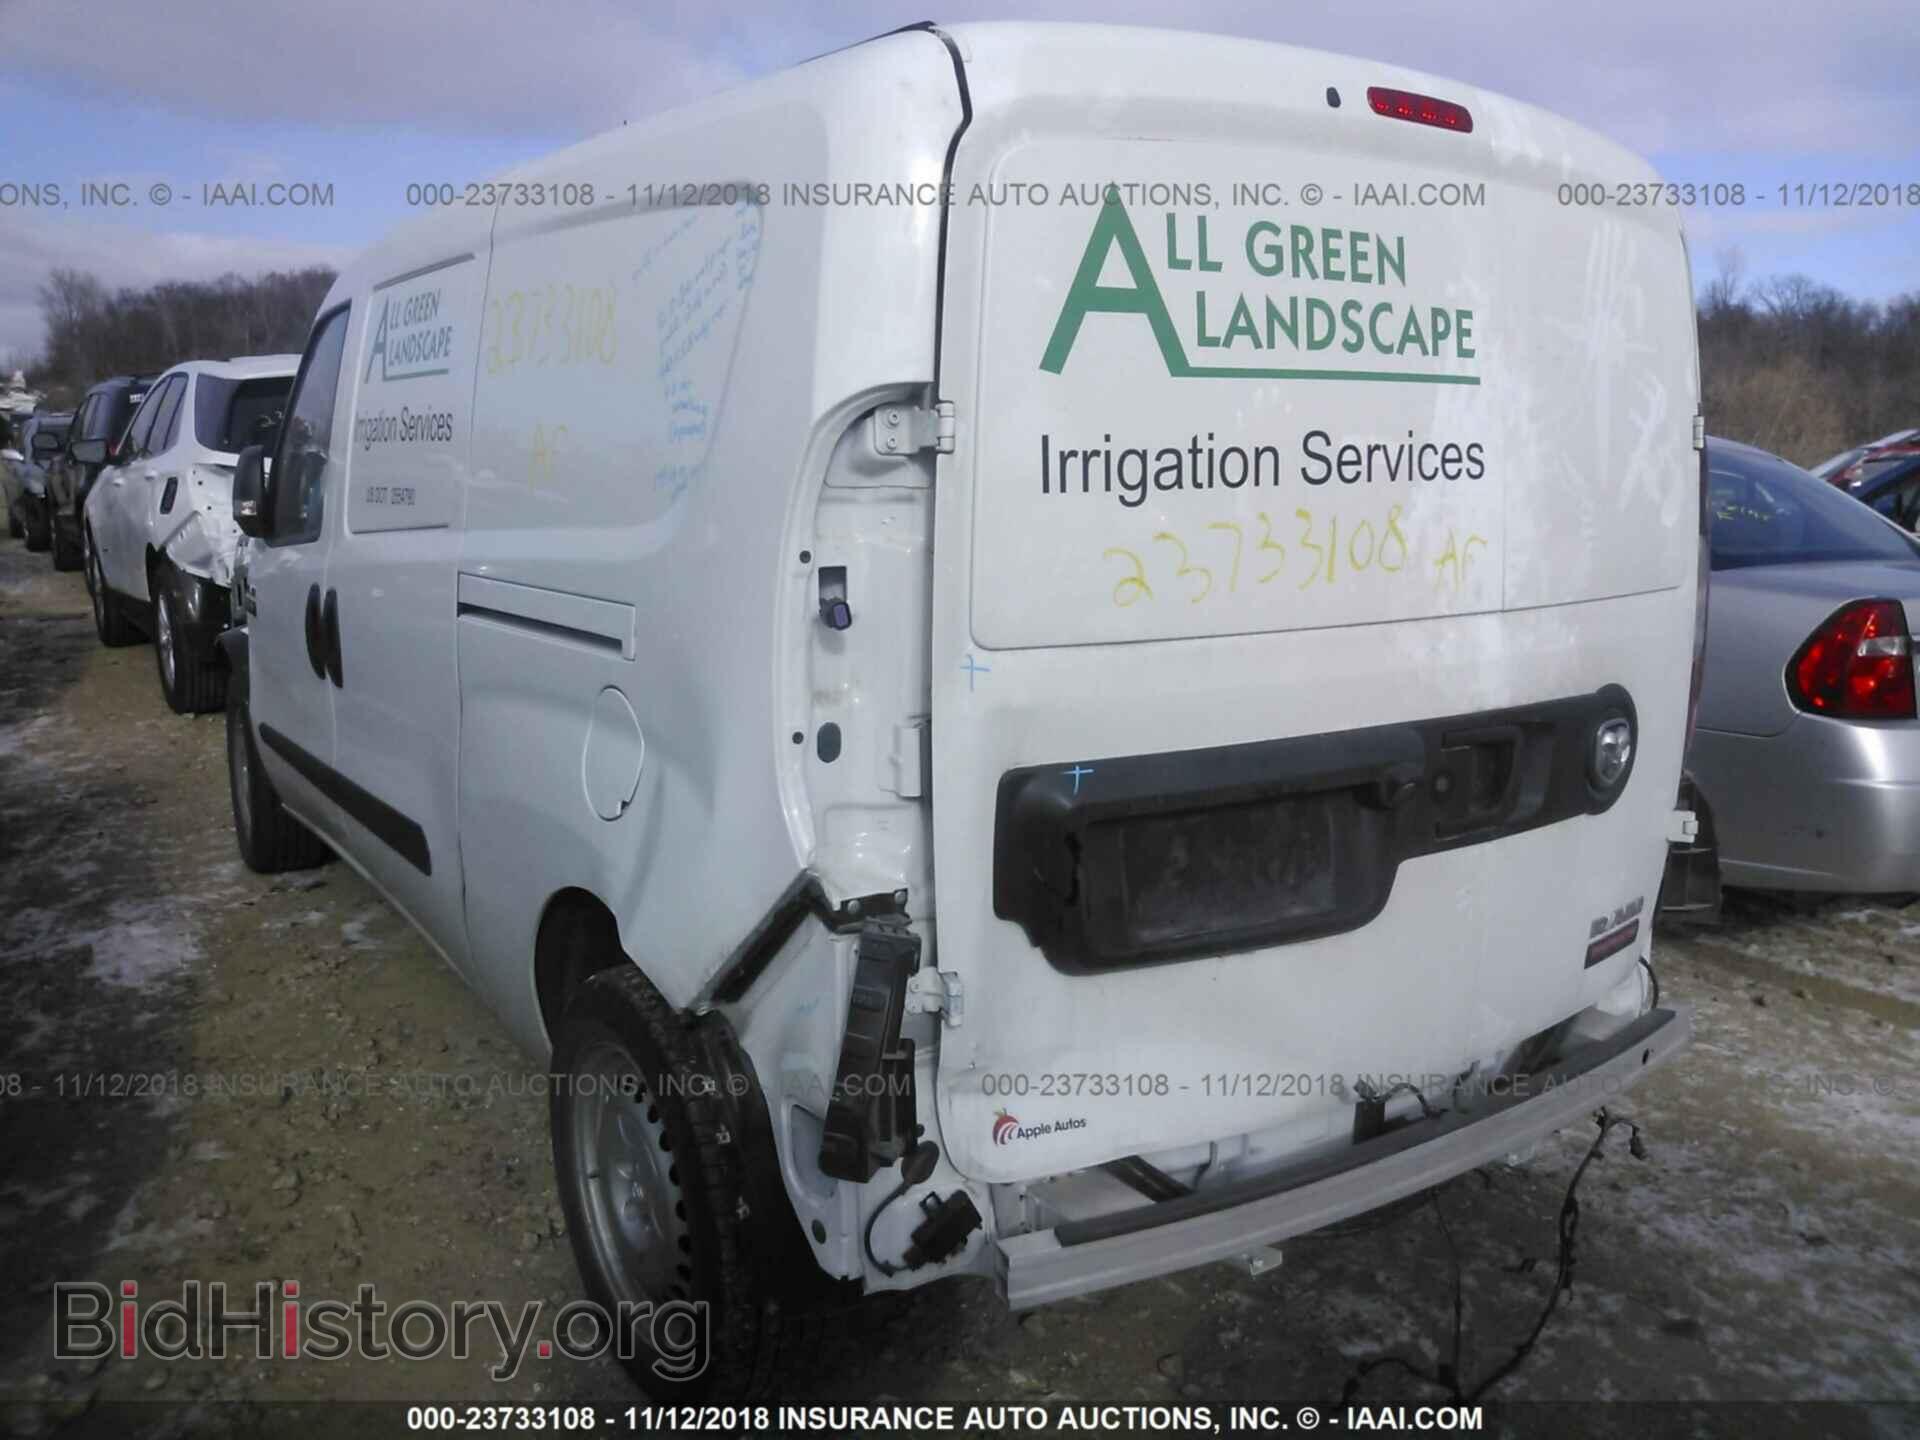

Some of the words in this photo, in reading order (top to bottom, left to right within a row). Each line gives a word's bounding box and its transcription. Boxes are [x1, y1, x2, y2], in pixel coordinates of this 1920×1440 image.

[1245, 220, 1407, 287] GREEN
[402, 288, 441, 327] GREEN
[1196, 290, 1477, 359] LANDSCAPE
[388, 325, 453, 367] LANDSCAPE
[399, 405, 453, 442] Services
[1041, 433, 1280, 508] Irrigation
[1300, 430, 1486, 486] Services
[1103, 504, 1409, 607] 23733108
[1016, 1123, 1052, 1141] Apple
[1053, 1117, 1088, 1133] Autos
